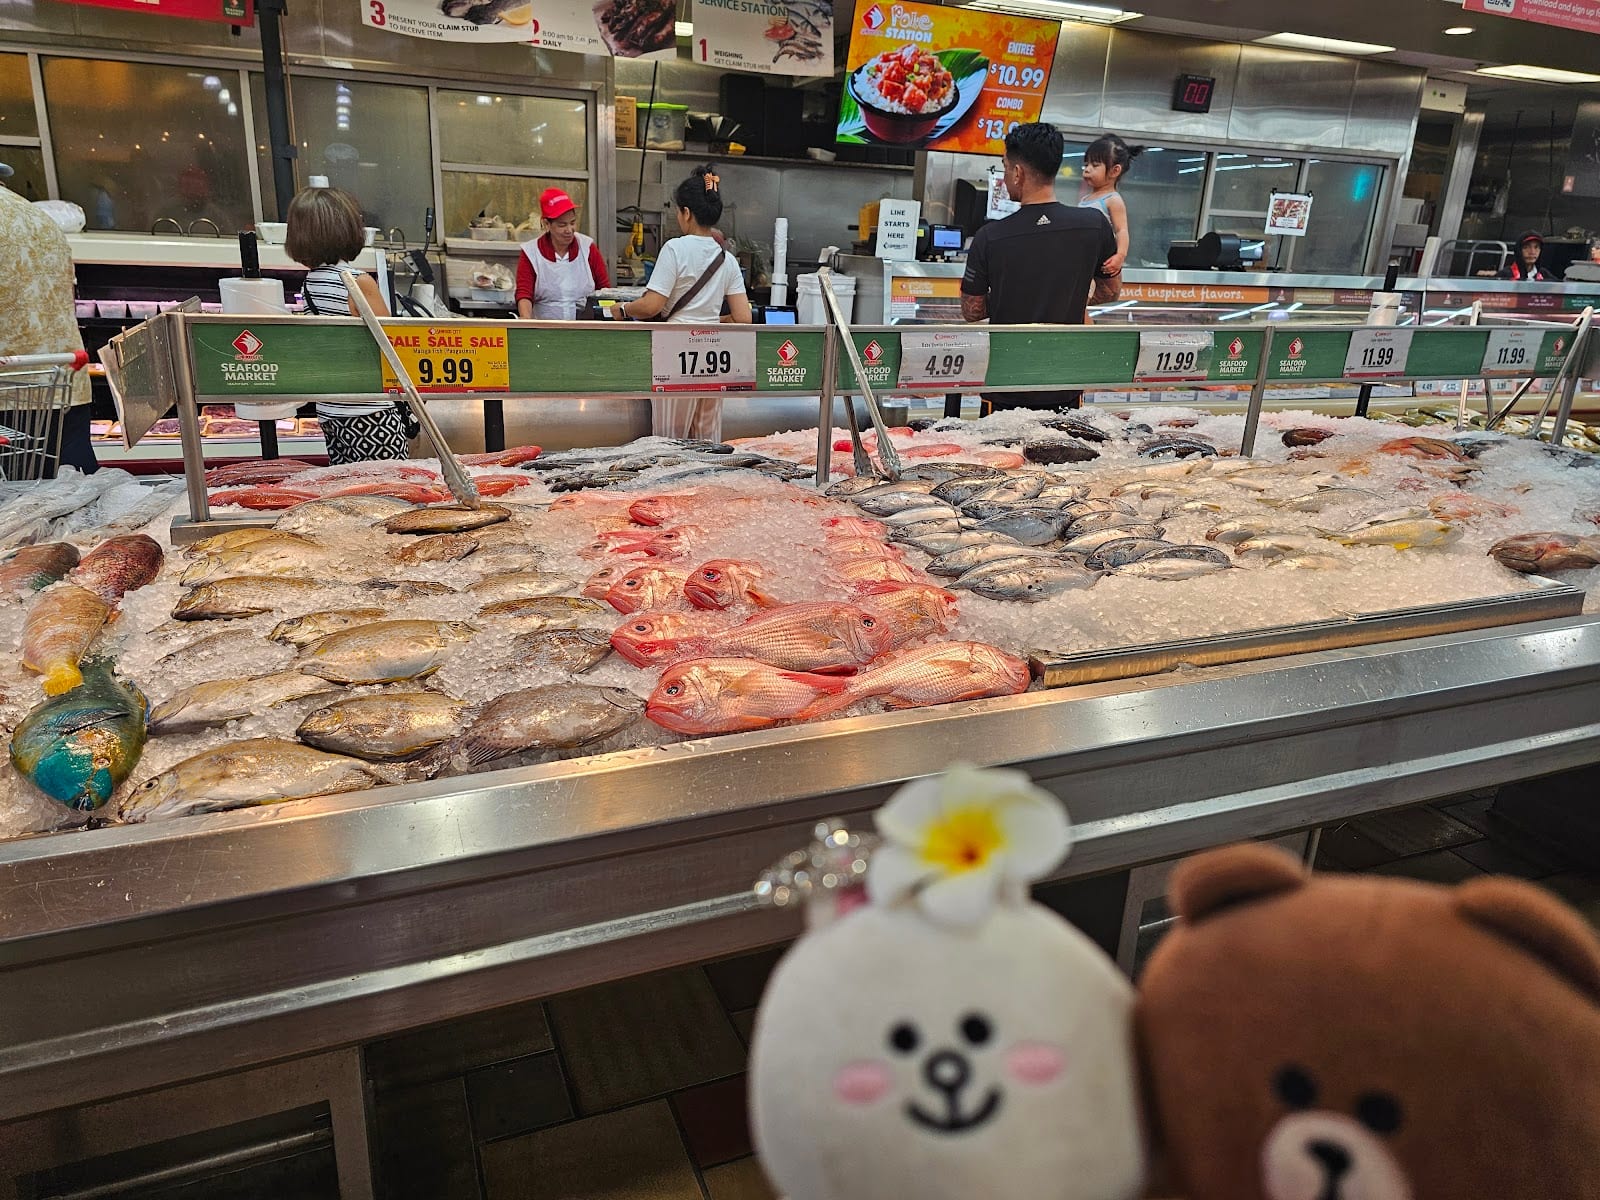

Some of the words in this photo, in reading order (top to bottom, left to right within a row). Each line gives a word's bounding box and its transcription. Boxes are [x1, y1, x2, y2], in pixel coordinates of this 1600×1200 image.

[369, 0, 386, 26] 3
[741, 2, 787, 17] STATION
[1557, 3, 1572, 12] and
[1572, 4, 1586, 17] sign
[1586, 8, 1595, 19] up
[388, 14, 416, 26] PRESENT
[417, 20, 437, 29] YOUR
[437, 23, 460, 32] CLAIM
[389, 22, 398, 30] TO
[399, 25, 426, 36] RECEIVE
[427, 30, 443, 38] ITEM
[588, 37, 599, 45] pm
[885, 27, 933, 43] STATION
[542, 40, 562, 48] DAILY
[699, 38, 707, 62] 1
[1007, 42, 1036, 56] ENTREE
[714, 50, 743, 60] WEIGHING
[714, 58, 725, 66] GET
[725, 59, 742, 68] CLAIM
[743, 62, 757, 70] STUB
[990, 64, 1045, 89] $10.99
[996, 96, 1024, 110] COMBO
[1120, 286, 1143, 298] and
[1147, 287, 1196, 302] inspired
[1200, 286, 1245, 301] flavors.
[386, 335, 421, 348] SALE
[427, 336, 463, 348] SALE
[470, 336, 504, 348] SALE
[678, 350, 731, 375] 17.99
[1156, 351, 1195, 371] 11.99
[1362, 347, 1394, 366] 11.99
[1497, 347, 1526, 365] 11.99
[221, 363, 279, 372] SEAFOOD
[418, 358, 473, 384] 9.99
[767, 367, 807, 375] SEAFOOD
[854, 366, 891, 375] AFOOD
[925, 354, 965, 376] 4.99
[224, 372, 277, 381] MARKET
[768, 375, 805, 383] MARKET
